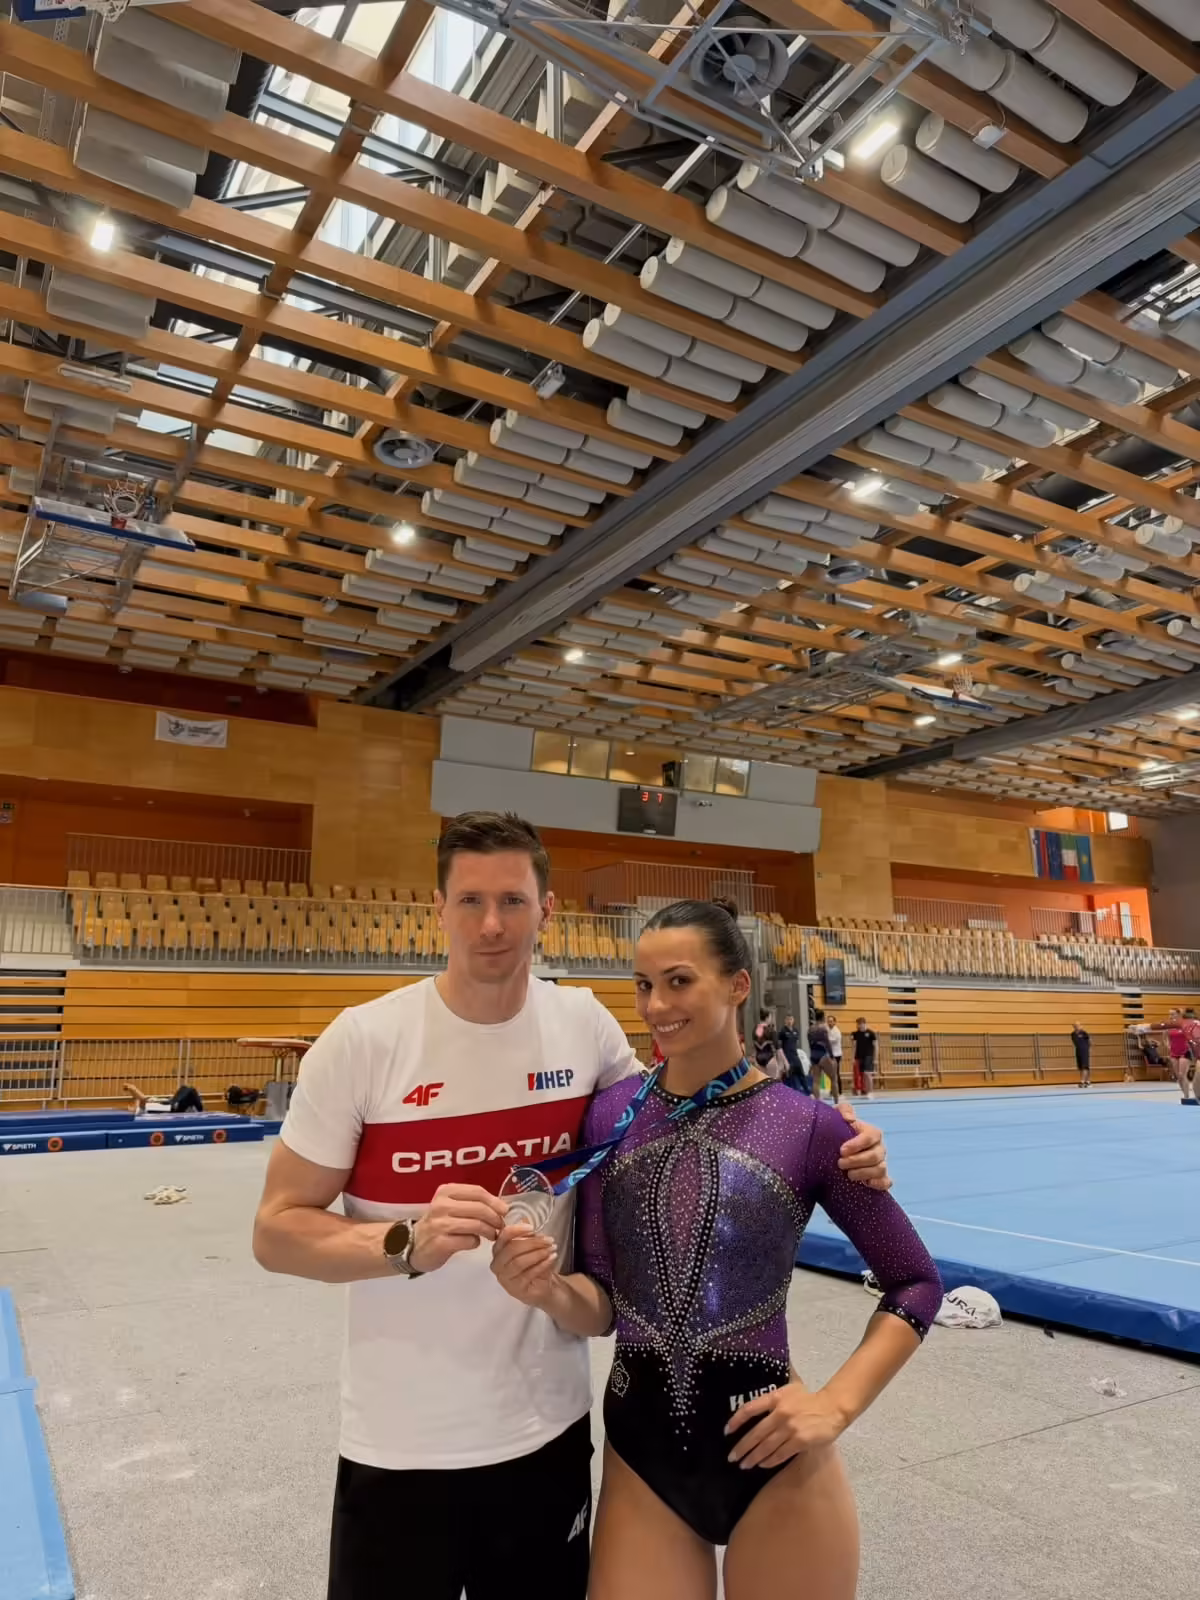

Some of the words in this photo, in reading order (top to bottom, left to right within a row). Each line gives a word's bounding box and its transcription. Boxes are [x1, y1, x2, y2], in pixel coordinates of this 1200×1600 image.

[544, 1069, 574, 1090] HEP
[402, 1082, 444, 1107] 4F
[391, 1132, 571, 1173] CROATIA
